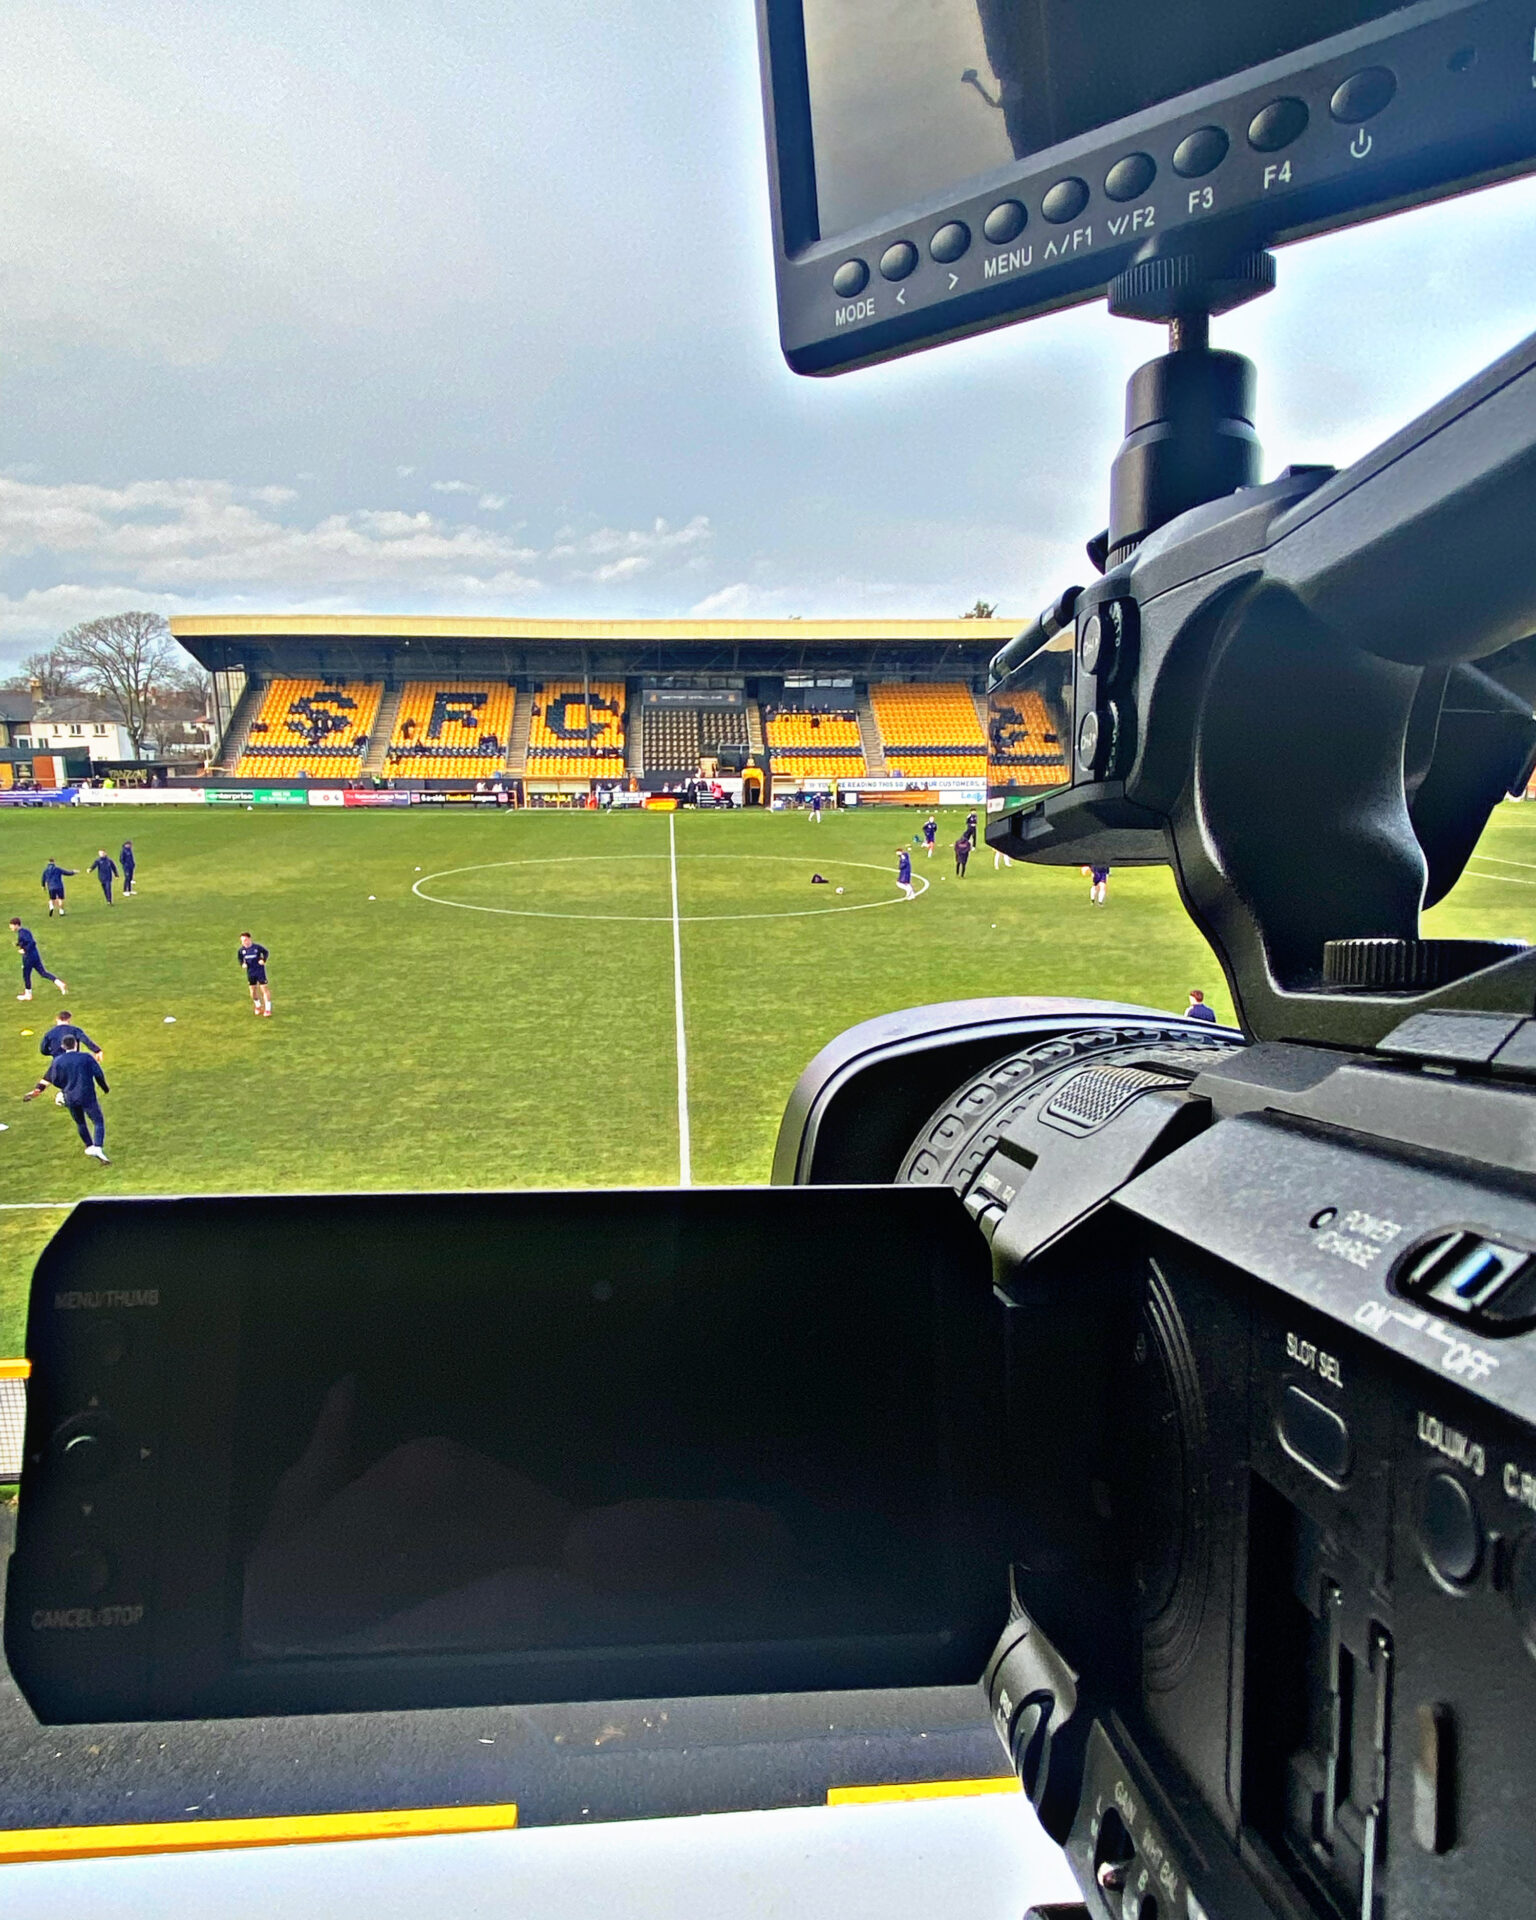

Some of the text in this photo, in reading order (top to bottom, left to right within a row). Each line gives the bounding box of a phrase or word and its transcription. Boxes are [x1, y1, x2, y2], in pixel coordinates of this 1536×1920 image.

[1263, 160, 1292, 190] F4
[1188, 186, 1214, 214] F3
[983, 244, 1033, 280] MENU
[834, 297, 876, 327] MODE
[1353, 1300, 1389, 1333] ON
[1286, 1331, 1344, 1388] SLOT SEL
[1441, 1339, 1500, 1381] OFF
